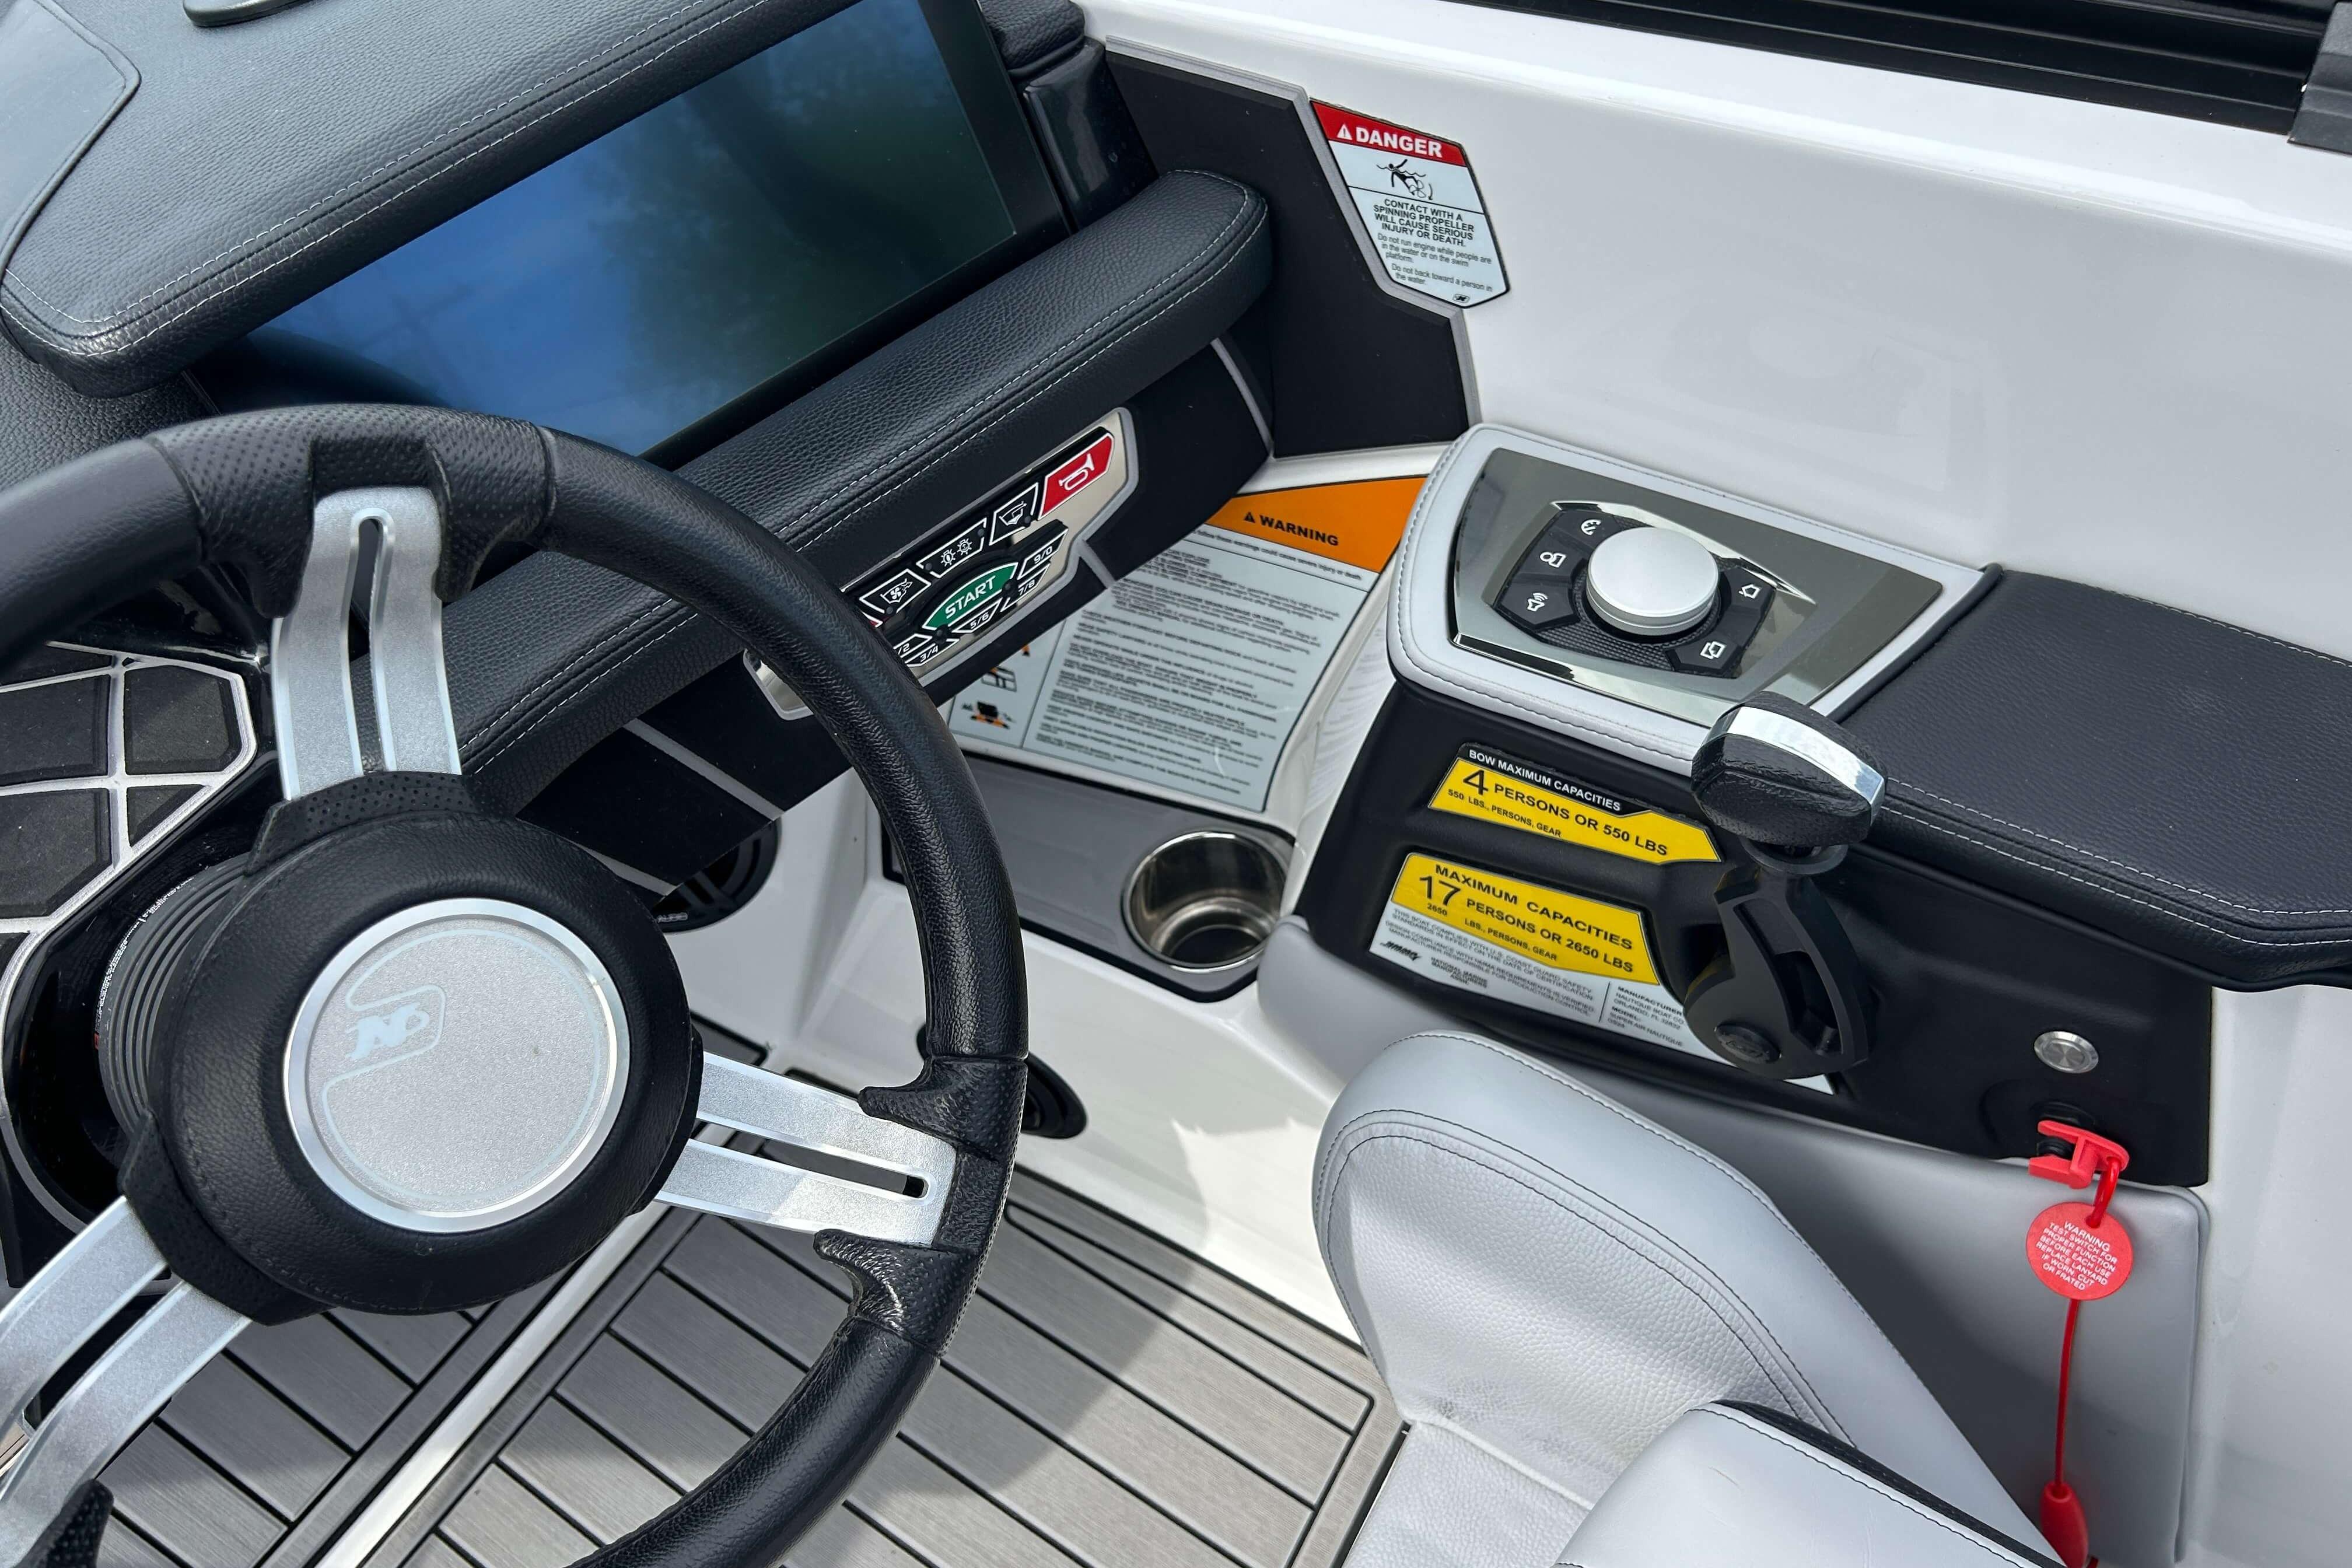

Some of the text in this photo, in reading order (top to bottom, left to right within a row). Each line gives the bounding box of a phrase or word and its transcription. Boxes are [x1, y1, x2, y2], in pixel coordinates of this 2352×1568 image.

[1356, 127, 1442, 158] DANGER
[1373, 204, 1474, 232] SPINNING PROPELLER
[1384, 198, 1427, 214] CONTACT
[1430, 208, 1452, 219] WITH
[1374, 212, 1472, 240] WILL CAUSE SERIOUS
[1381, 222, 1465, 247] INJURY OR DEATH.
[1378, 233, 1387, 241] Do
[1389, 235, 1399, 244] not
[1413, 242, 1435, 253] engine
[1437, 246, 1454, 256] while
[1455, 250, 1478, 262] people
[1480, 256, 1492, 264] are
[1260, 514, 1339, 547] WARNING
[1034, 546, 1053, 564] 9/0
[946, 575, 996, 619] START
[1019, 580, 1035, 595] 7/8
[970, 612, 989, 629] 5/6
[898, 643, 910, 654] /2
[920, 645, 939, 662] 3/4
[1469, 749, 1620, 811] BOW MAXIMUM CAPACITIES
[1447, 789, 1464, 799] 550
[1492, 804, 1534, 827] PERSONS,
[1536, 822, 1561, 837] GEAR
[1462, 769, 1667, 855] 4 PERSONS OR 550 LBS
[1435, 864, 1632, 949] MAXIMUM CAPACITIES
[1419, 876, 1633, 972] 17 PERSONS OR 2650 LBS
[1427, 903, 1447, 916] 2650
[1488, 928, 1529, 950] PERSONS,
[1532, 946, 1557, 961] GEAR
[2043, 1227, 2116, 1272] PROPER FUNCTION
[2050, 1222, 2118, 1264] TEST SWITCH FOR
[2064, 1221, 2110, 1252] WARNING
[2036, 1241, 2108, 1286] REPLACE LANYARD
[2040, 1234, 2111, 1278] BEFORE EACH USE
[2043, 1262, 2055, 1272] OR
[2077, 1273, 2095, 1286] CUT
